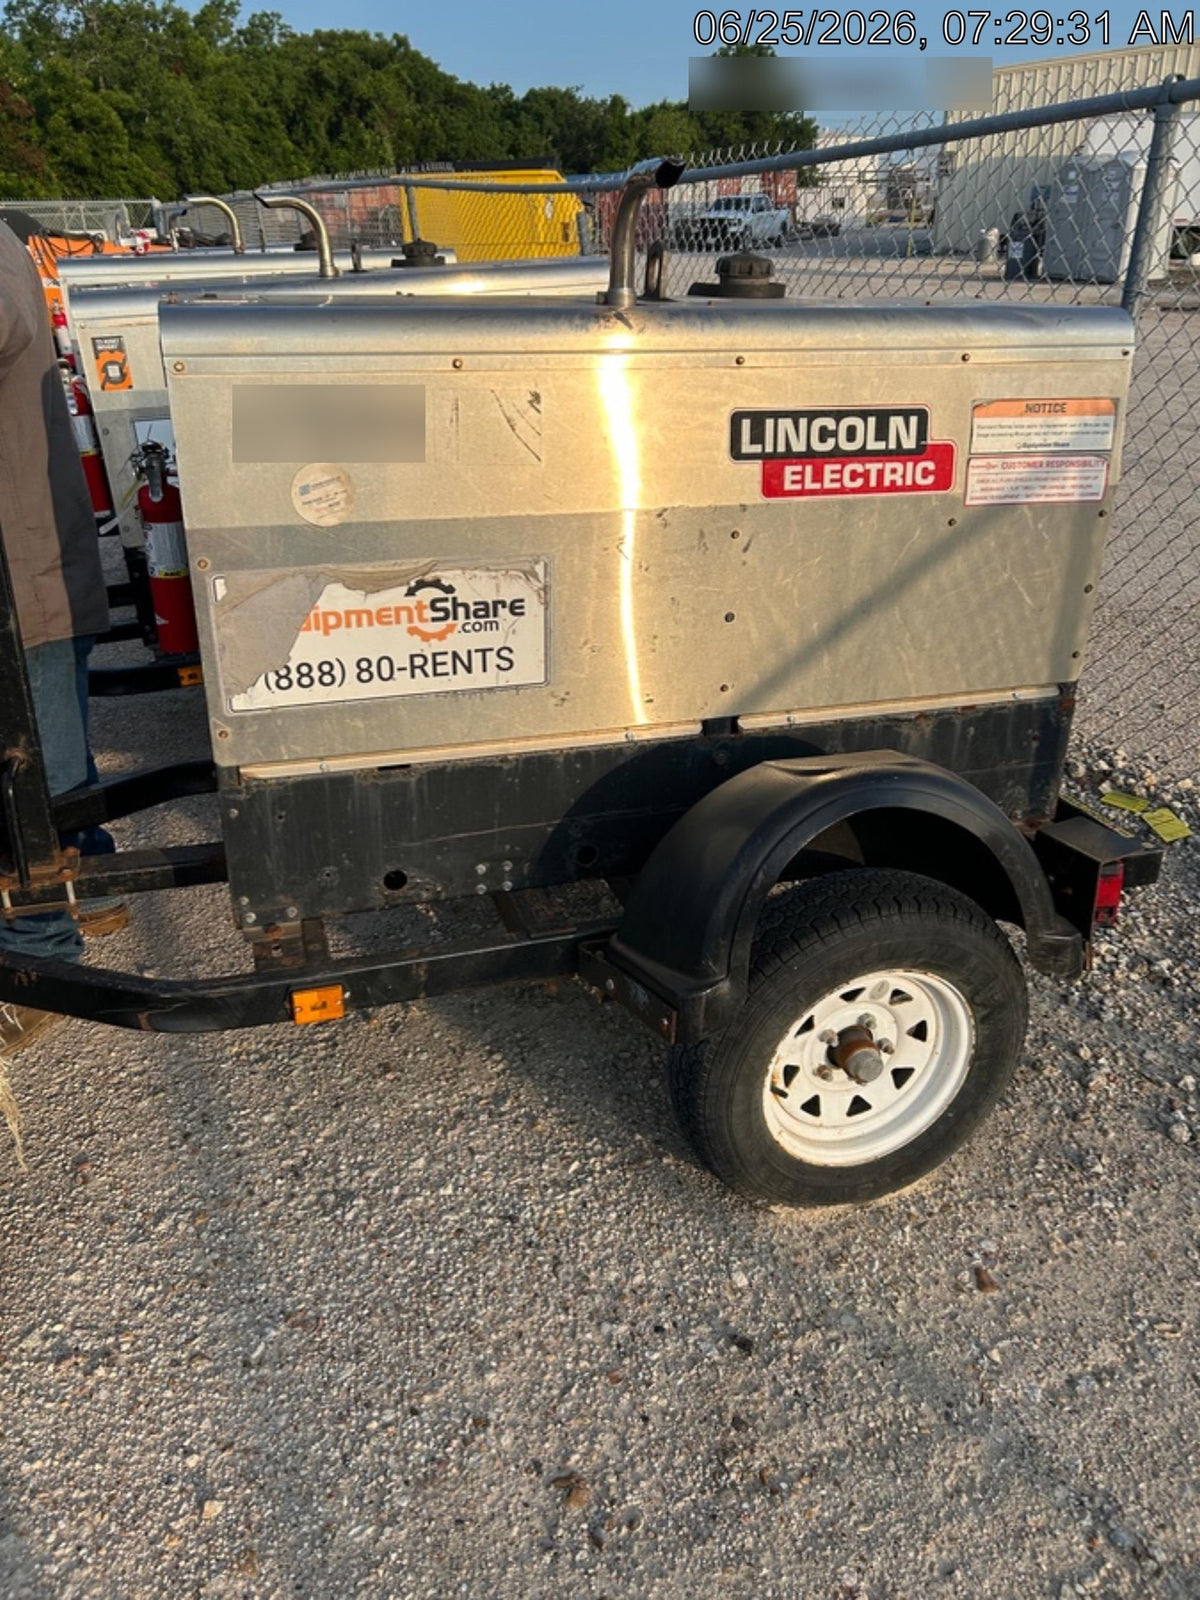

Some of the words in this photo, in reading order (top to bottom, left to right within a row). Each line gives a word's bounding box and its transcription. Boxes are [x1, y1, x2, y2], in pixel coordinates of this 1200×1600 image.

[1024, 402, 1068, 414] NOTICE
[740, 415, 919, 454] LINCOLN
[783, 460, 936, 492] ELECTRIC
[1001, 460, 1043, 470] CUSTOMER
[457, 619, 500, 634] .com
[264, 656, 347, 694] (888)
[355, 645, 515, 684] 80-RENTS
